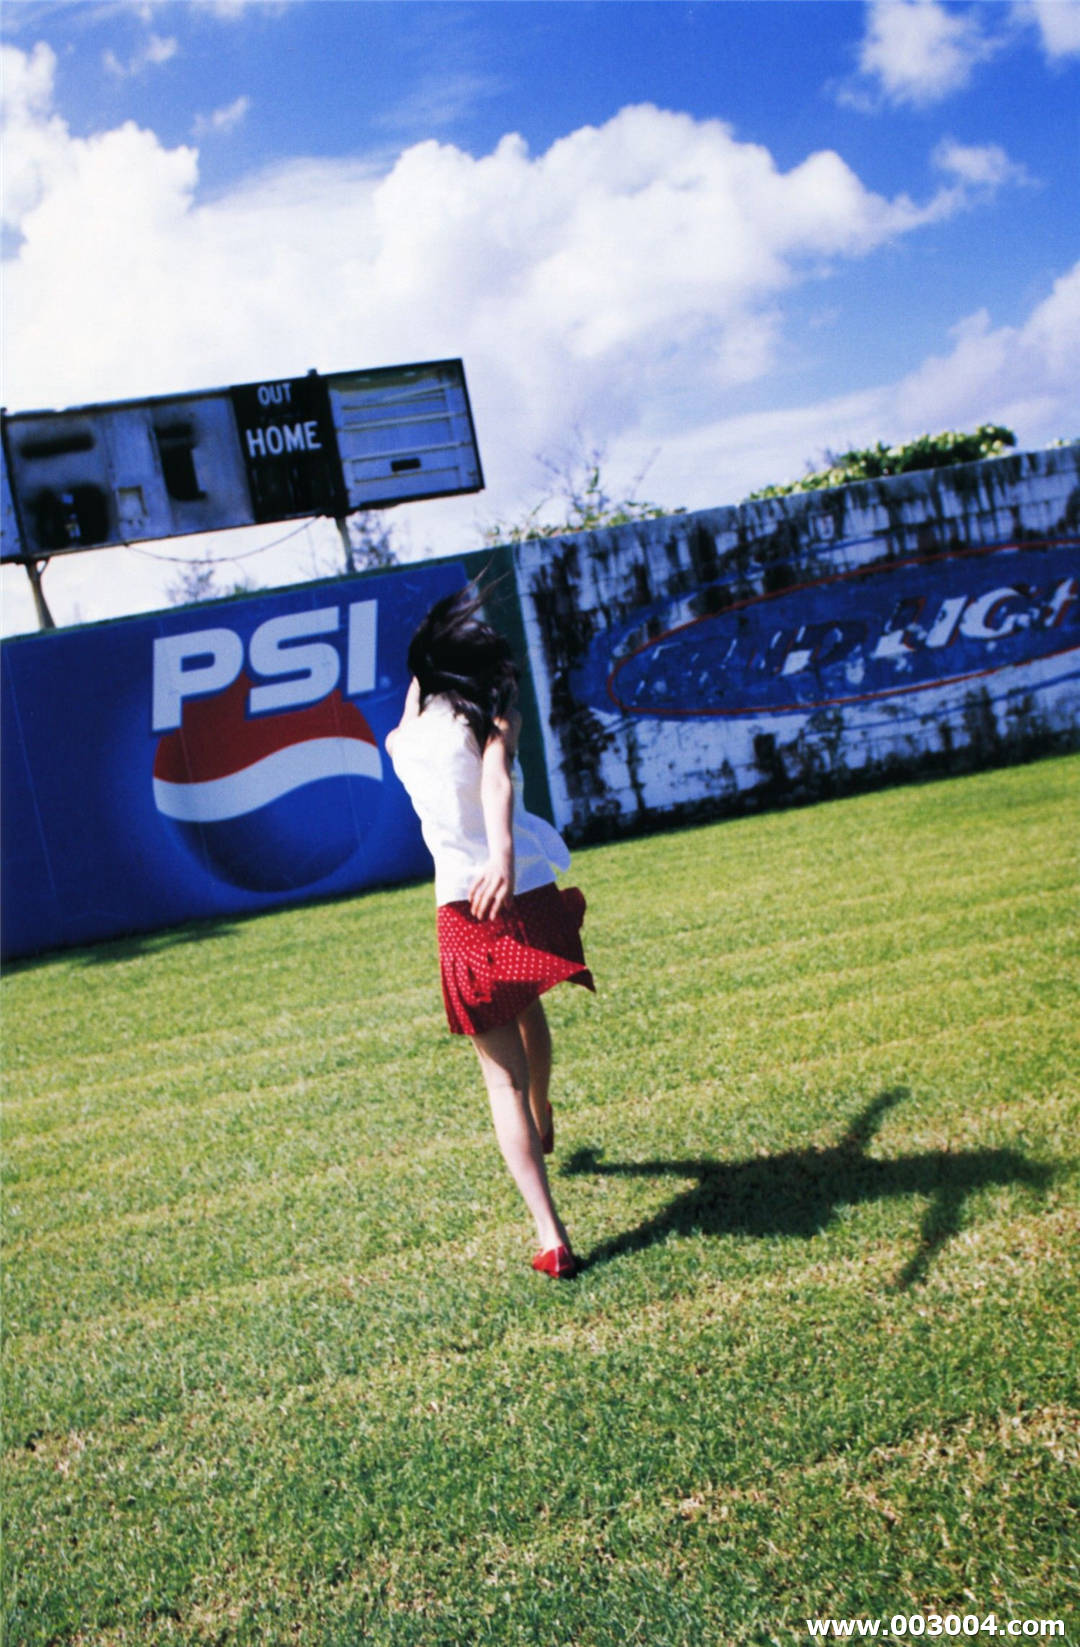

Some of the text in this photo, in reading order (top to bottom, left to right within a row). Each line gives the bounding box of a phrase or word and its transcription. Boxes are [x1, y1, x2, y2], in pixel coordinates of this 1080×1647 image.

[257, 382, 292, 407] OUT
[245, 420, 322, 458] HOME
[152, 599, 378, 732] PSI
